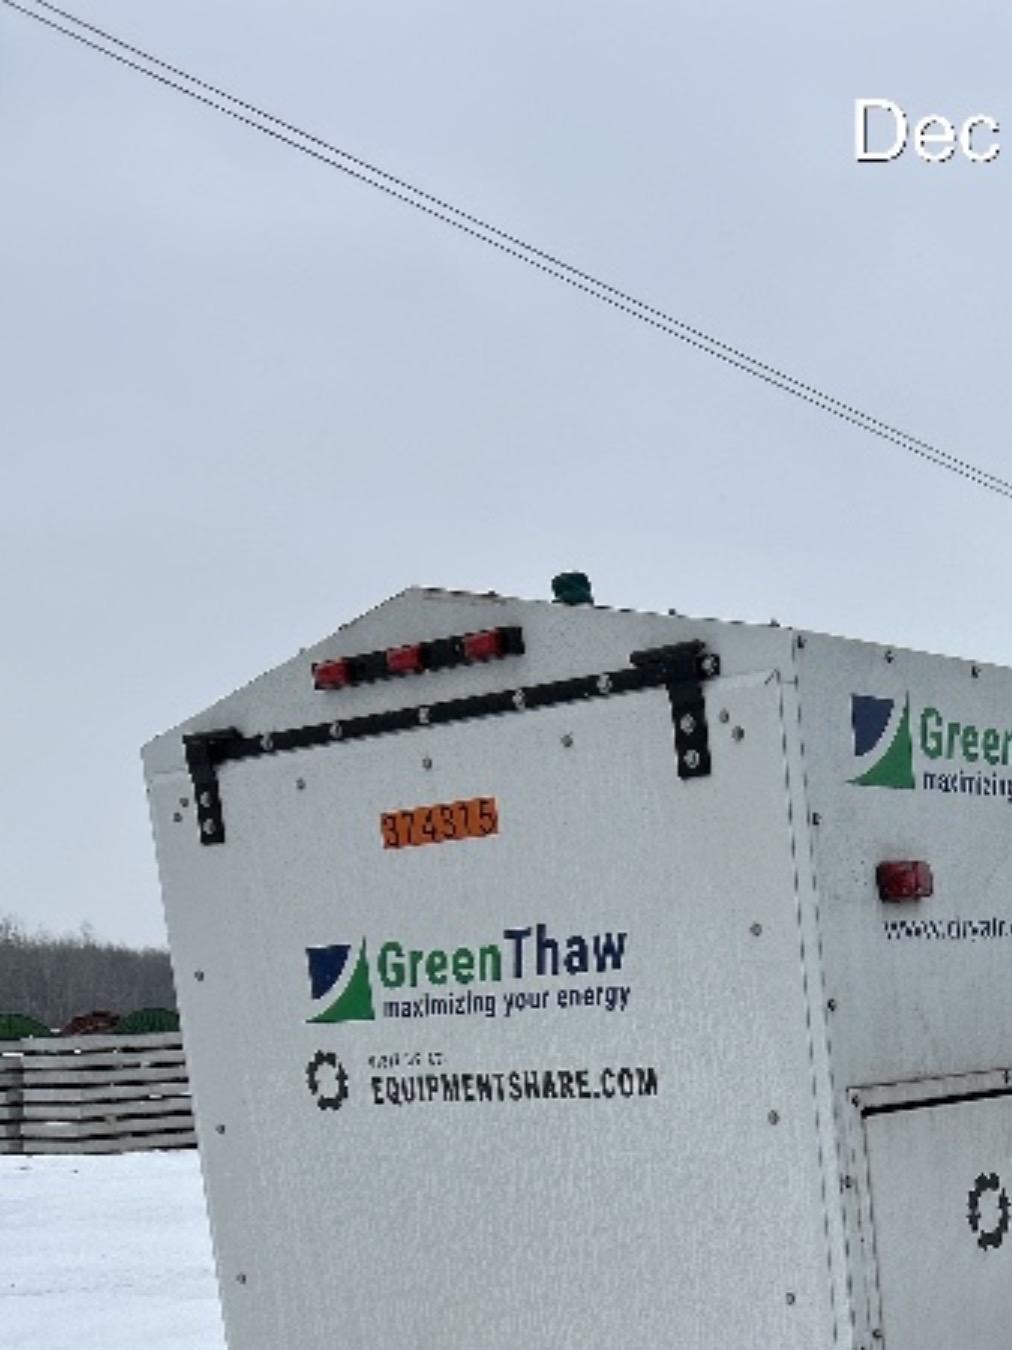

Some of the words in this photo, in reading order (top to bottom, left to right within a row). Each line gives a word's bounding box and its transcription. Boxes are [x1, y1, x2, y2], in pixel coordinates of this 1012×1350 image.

[377, 923, 627, 988] GreenThaw
[382, 989, 496, 1018] maximizing
[503, 989, 549, 1017] your
[556, 985, 631, 1012] energy
[371, 1067, 658, 1106] EQUIPMENTSHARE.COM
